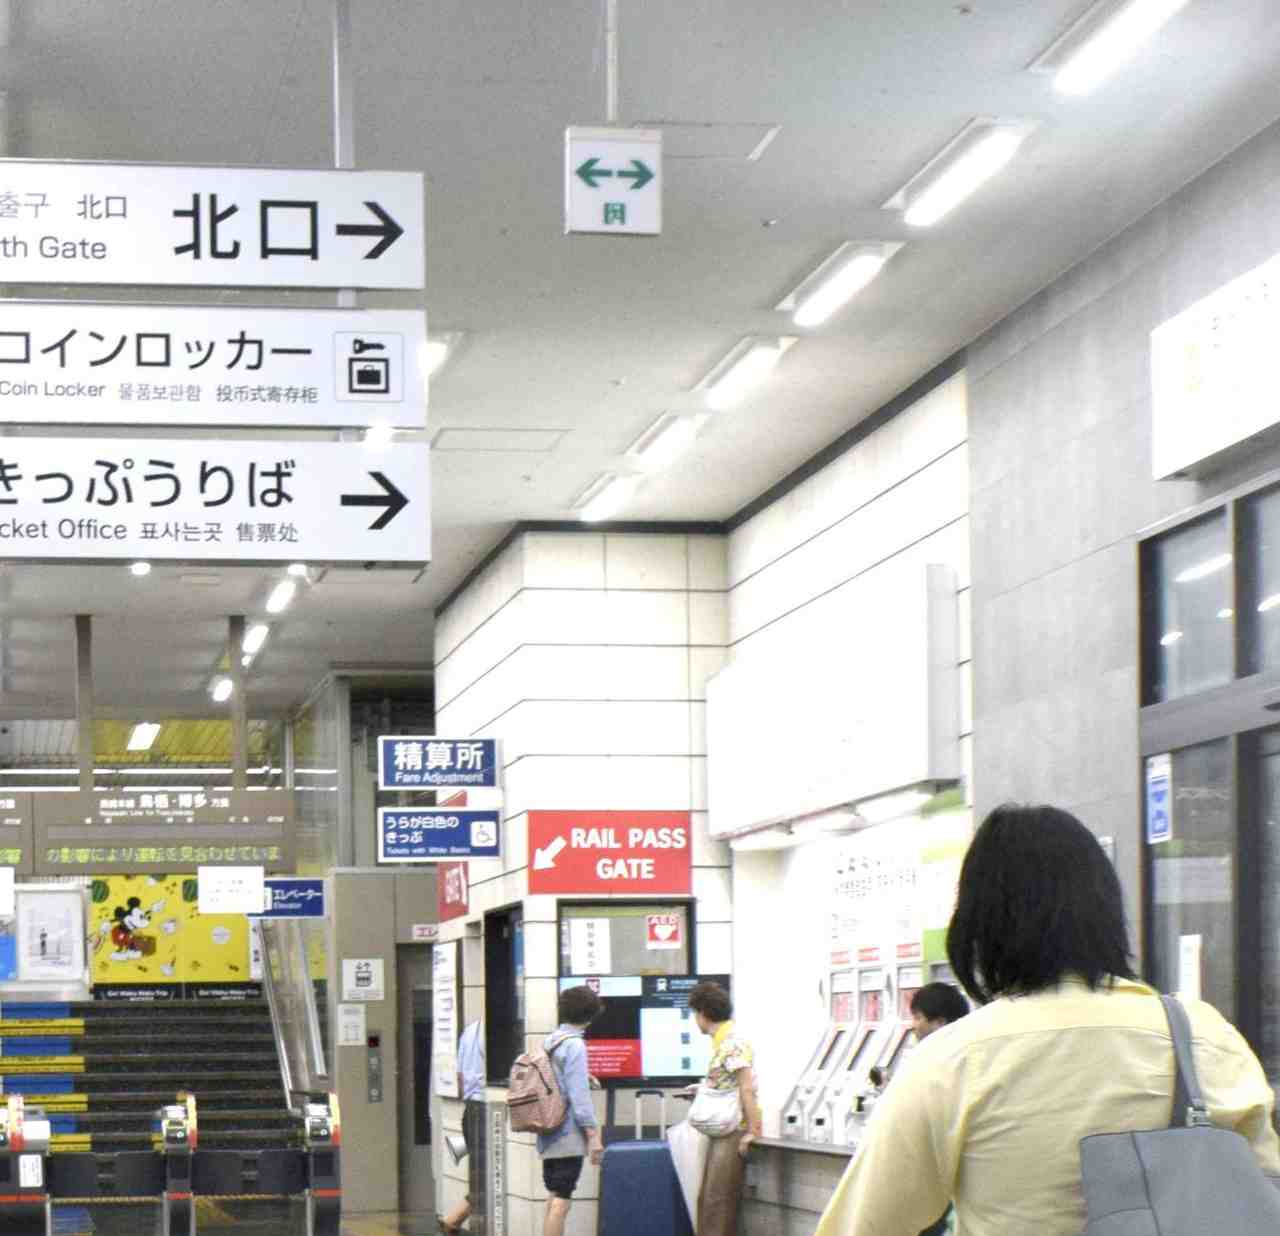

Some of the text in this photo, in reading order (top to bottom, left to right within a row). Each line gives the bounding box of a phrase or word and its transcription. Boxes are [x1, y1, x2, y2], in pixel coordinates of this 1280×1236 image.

[76, 194, 128, 220] 北口
[173, 193, 318, 260] 北口
[39, 237, 107, 260] Gate
[44, 382, 105, 398] Locker
[58, 518, 127, 541] Office
[236, 522, 299, 543] 售票处
[394, 741, 484, 770] 精算所
[395, 772, 483, 784] Fare Adjustment
[385, 816, 459, 829] うらが白色の
[385, 831, 423, 844] きっぷ
[571, 828, 686, 848] RAIL PASS
[596, 859, 655, 879] GATE
[274, 889, 323, 900] エレベーター
